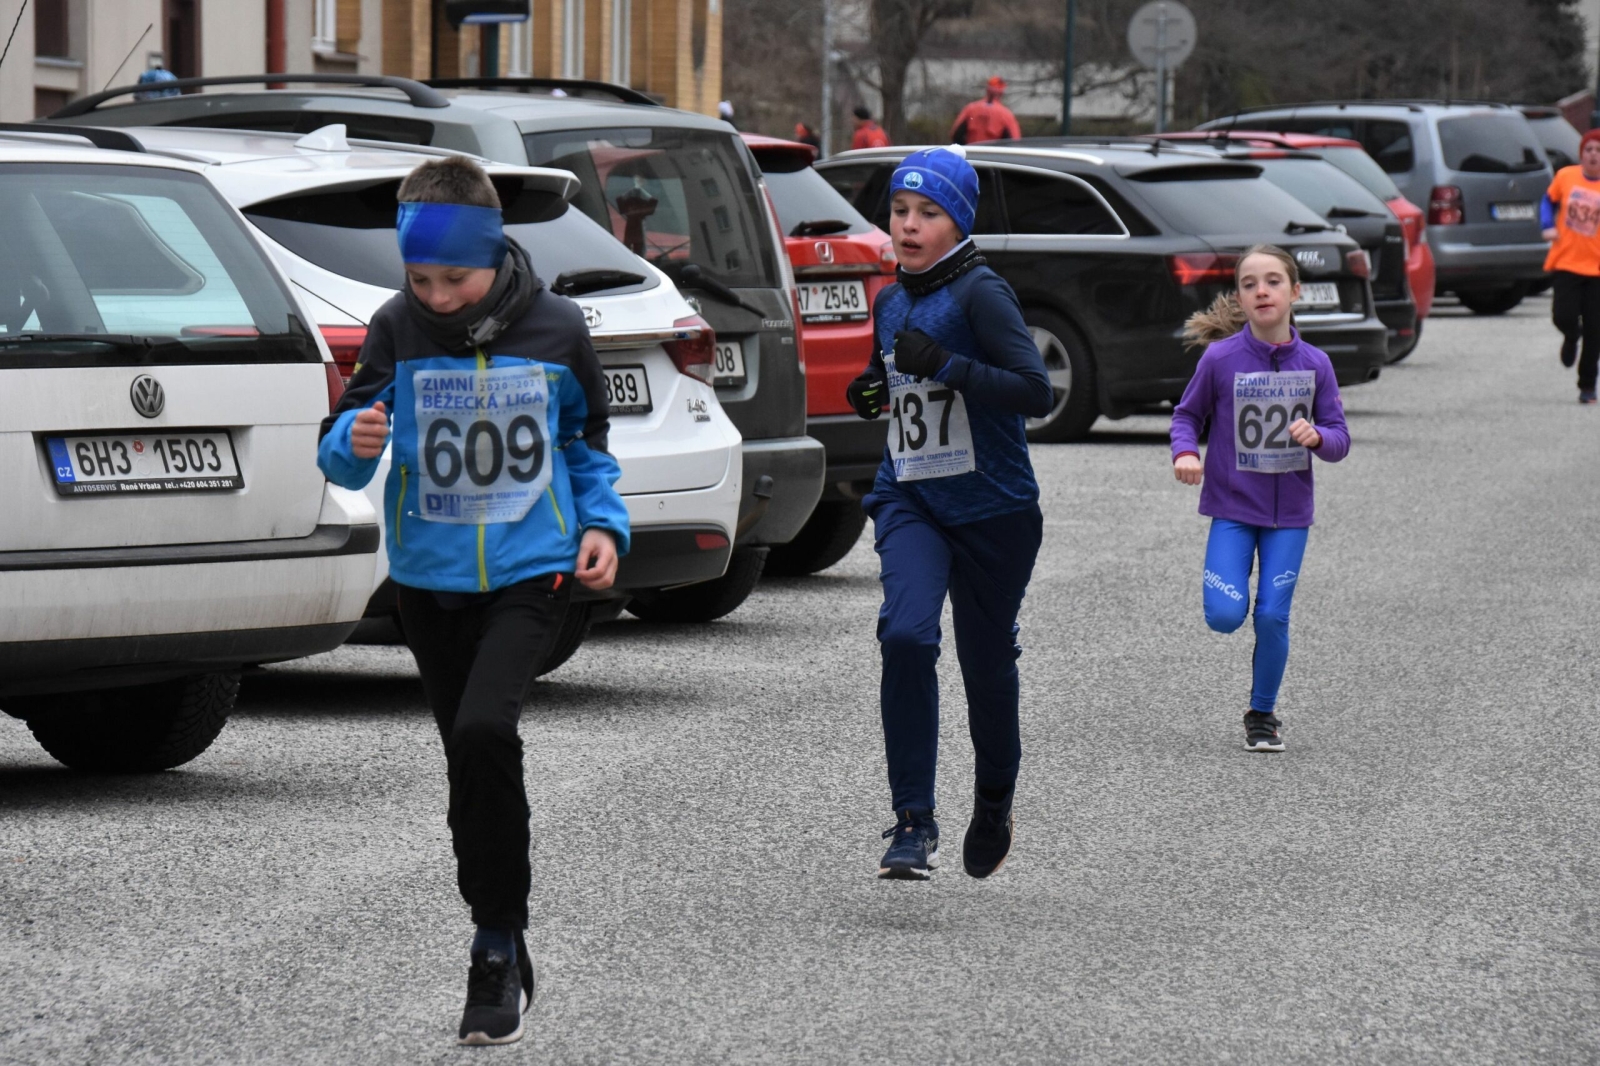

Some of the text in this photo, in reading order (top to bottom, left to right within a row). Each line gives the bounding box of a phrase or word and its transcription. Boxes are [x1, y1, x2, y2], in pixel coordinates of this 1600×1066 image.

[822, 284, 859, 309] 2548
[422, 375, 474, 391] ZIMNÍ
[1237, 376, 1270, 387] ZIMNÍ
[422, 391, 544, 409] BĚŽECKÁ LIGA
[1236, 387, 1311, 398] BĚŽECKÁ LIGA
[892, 389, 956, 453] 137
[1238, 403, 1309, 449] 622
[75, 438, 222, 477] 6H3 1503
[424, 414, 545, 488] 609
[57, 466, 73, 478] CZ
[73, 484, 117, 493] AUTOSERVIS
[120, 482, 138, 491] René
[139, 481, 162, 490] Vrbata
[196, 480, 208, 489] 604
[209, 480, 220, 488] 351
[221, 479, 233, 488] 281
[1203, 569, 1243, 601] olfinCar
